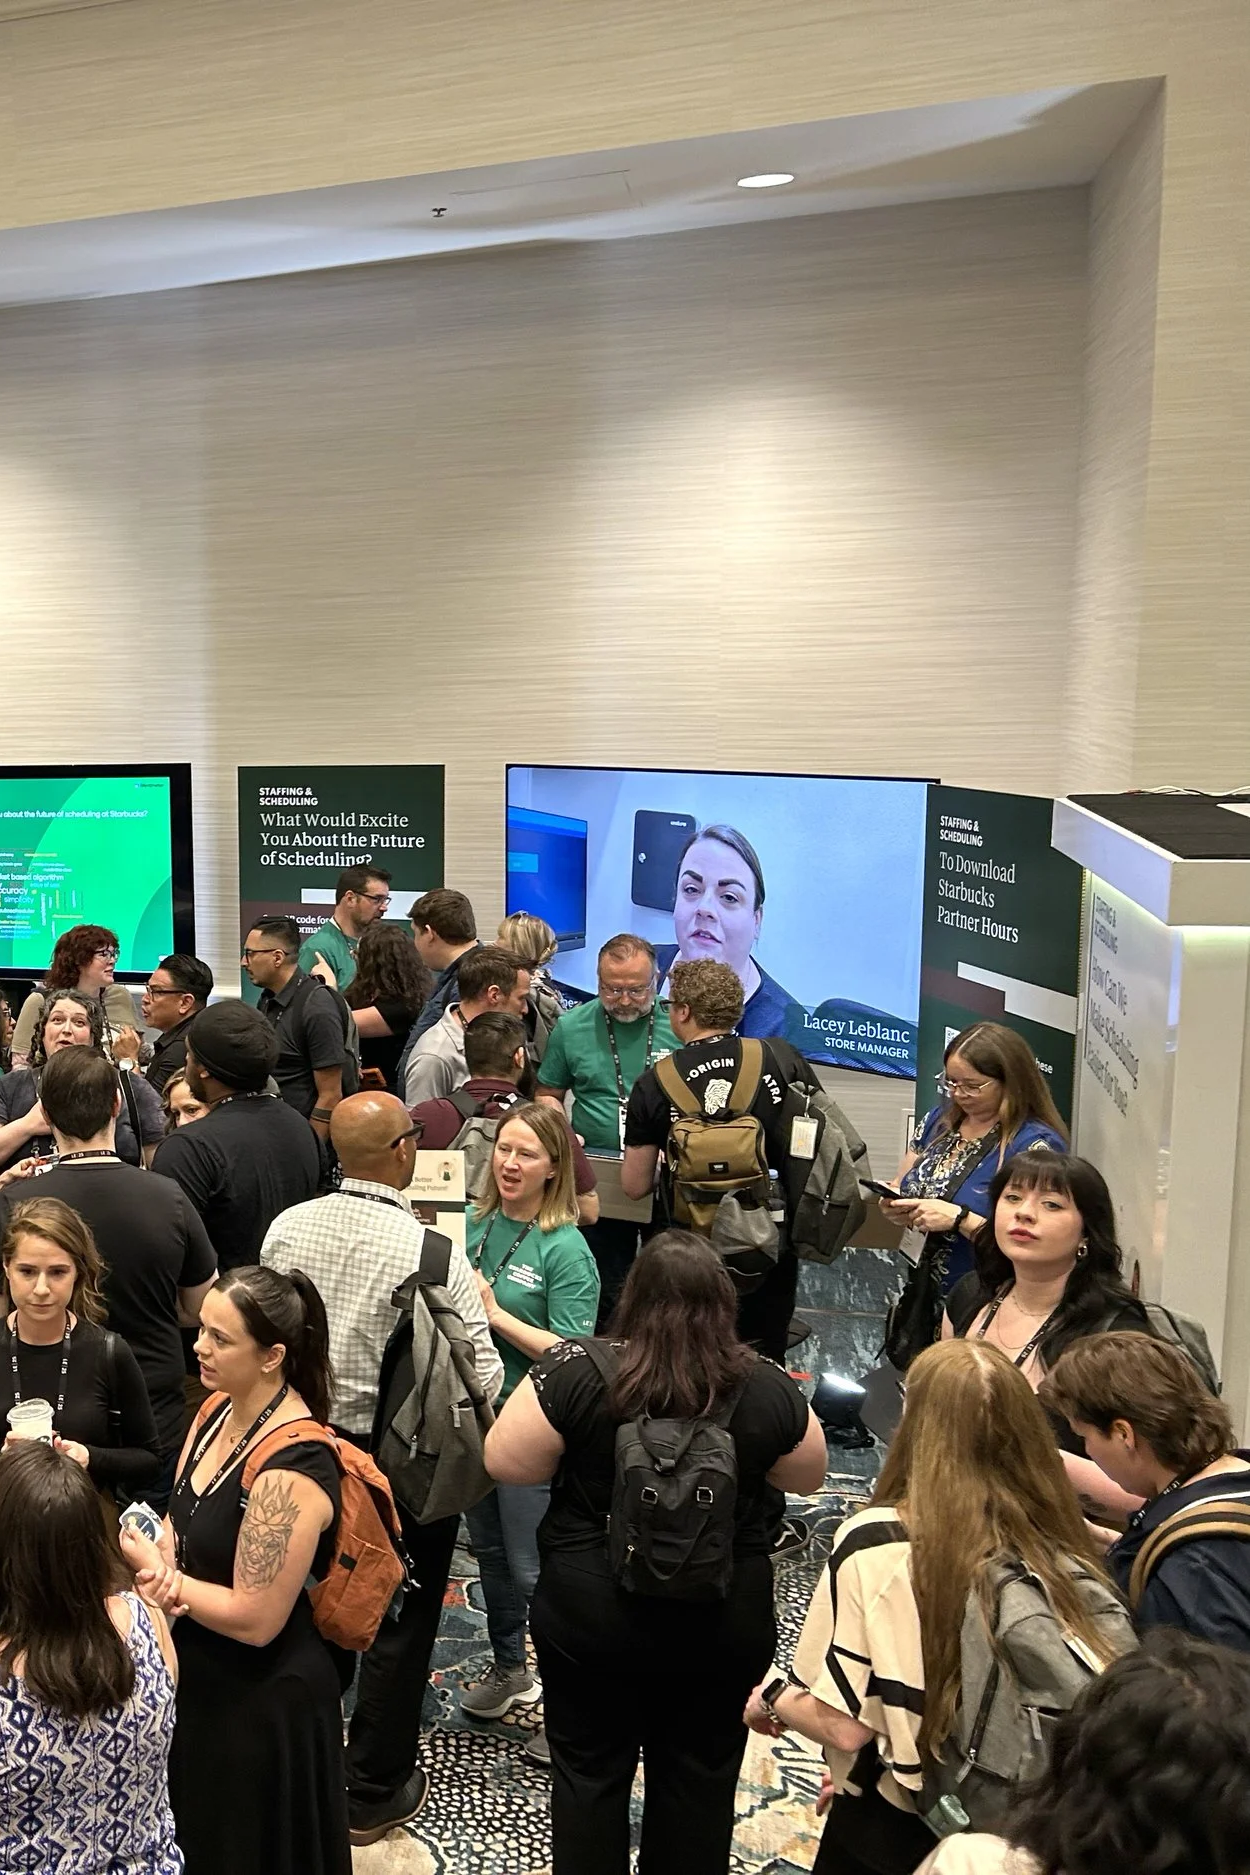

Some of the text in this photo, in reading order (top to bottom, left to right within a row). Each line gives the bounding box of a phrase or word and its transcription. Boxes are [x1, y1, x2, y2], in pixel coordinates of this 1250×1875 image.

[259, 787, 313, 796] STAFFING &
[259, 797, 318, 806] SCHEDULING
[260, 813, 409, 828] What Would Excite
[940, 816, 979, 832] STAFFING &
[260, 832, 426, 848] You About the Future
[940, 830, 982, 847] SCHEDULING
[260, 850, 372, 868] of Scheduling?
[940, 851, 1016, 884] To Download
[938, 879, 995, 908] Starbucks
[296, 916, 316, 924] code
[938, 906, 1018, 943] Partner Hours
[804, 1014, 910, 1044] Lacey Leblanc
[825, 1037, 908, 1060] STORE MANAGER
[762, 1074, 782, 1104] ATRA
